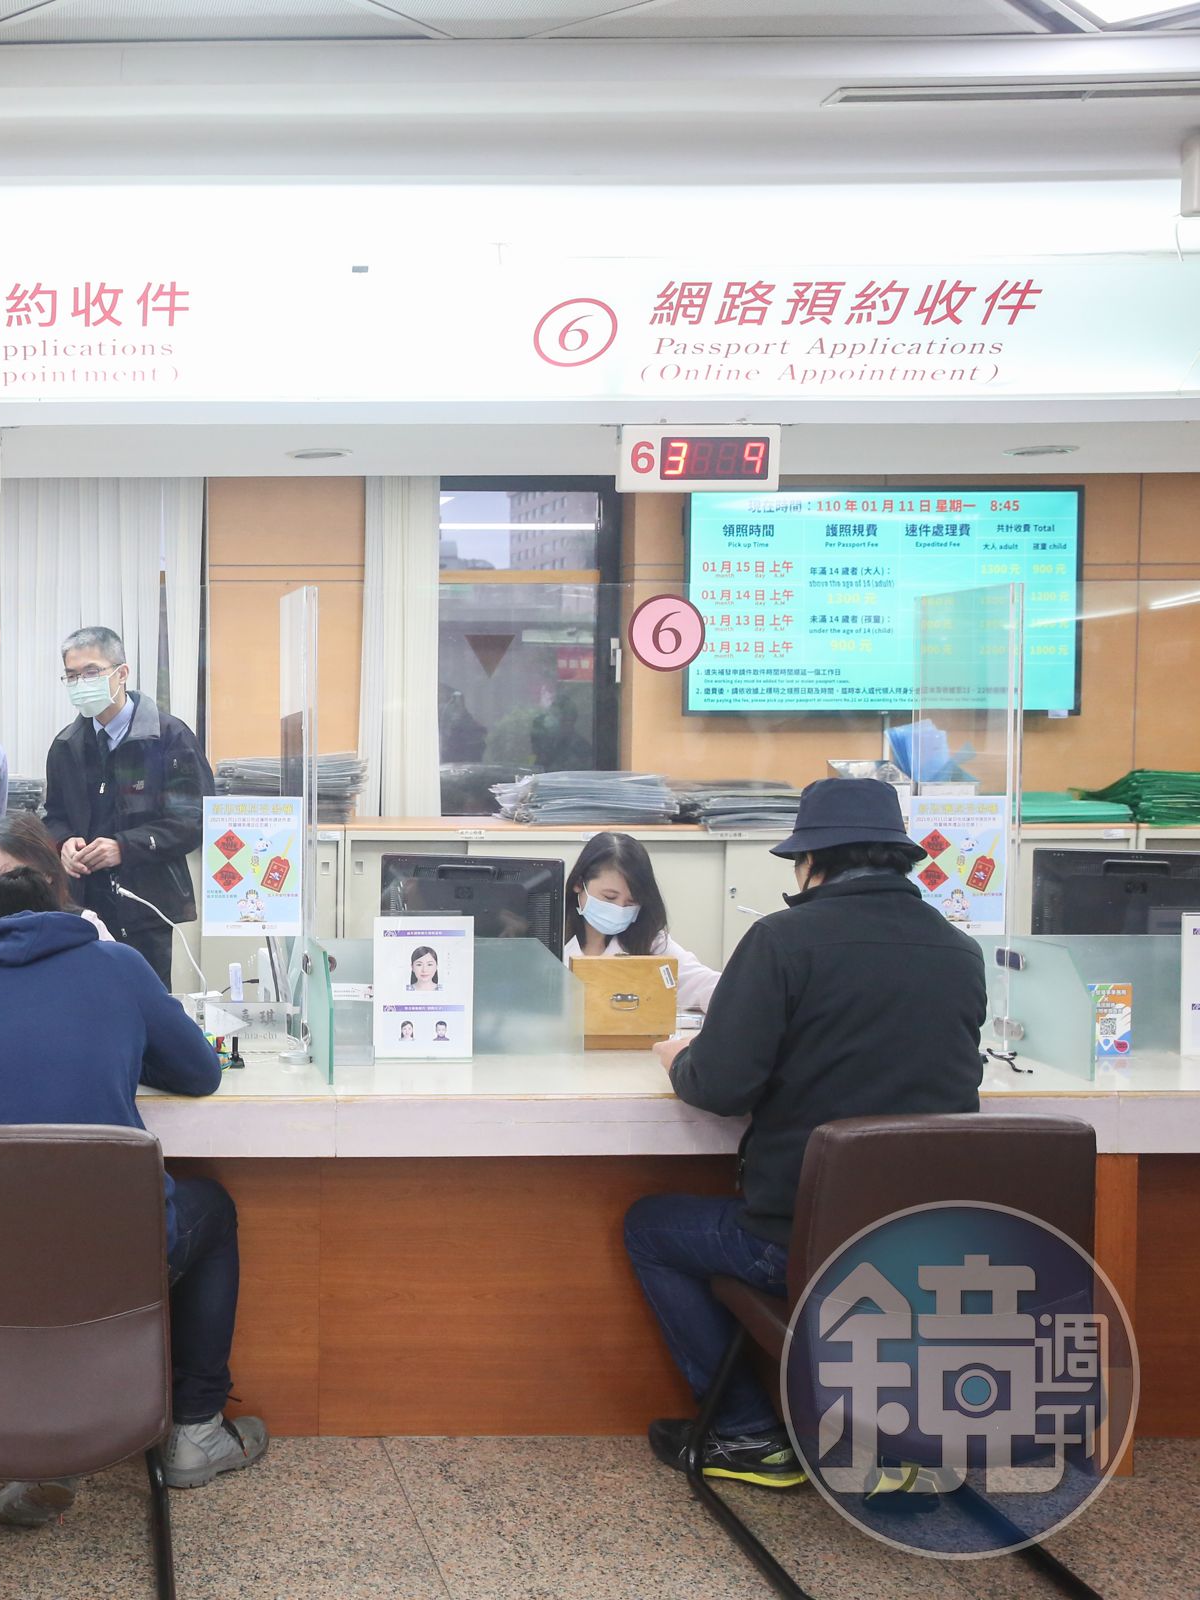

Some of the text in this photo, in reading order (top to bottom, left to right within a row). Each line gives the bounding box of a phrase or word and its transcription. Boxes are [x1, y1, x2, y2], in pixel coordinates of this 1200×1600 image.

[648, 279, 1043, 327] 網路預約收件
[558, 313, 591, 351] 6
[653, 336, 1004, 360] Passport Applications
[630, 441, 655, 474] 6
[991, 500, 1020, 511] 8:45
[723, 524, 774, 537] 領照時間
[826, 524, 878, 537] 護照規費
[905, 523, 971, 537] 速件處理費
[1033, 524, 1055, 532] Total
[915, 541, 948, 549] Expedited
[652, 610, 682, 655] 6
